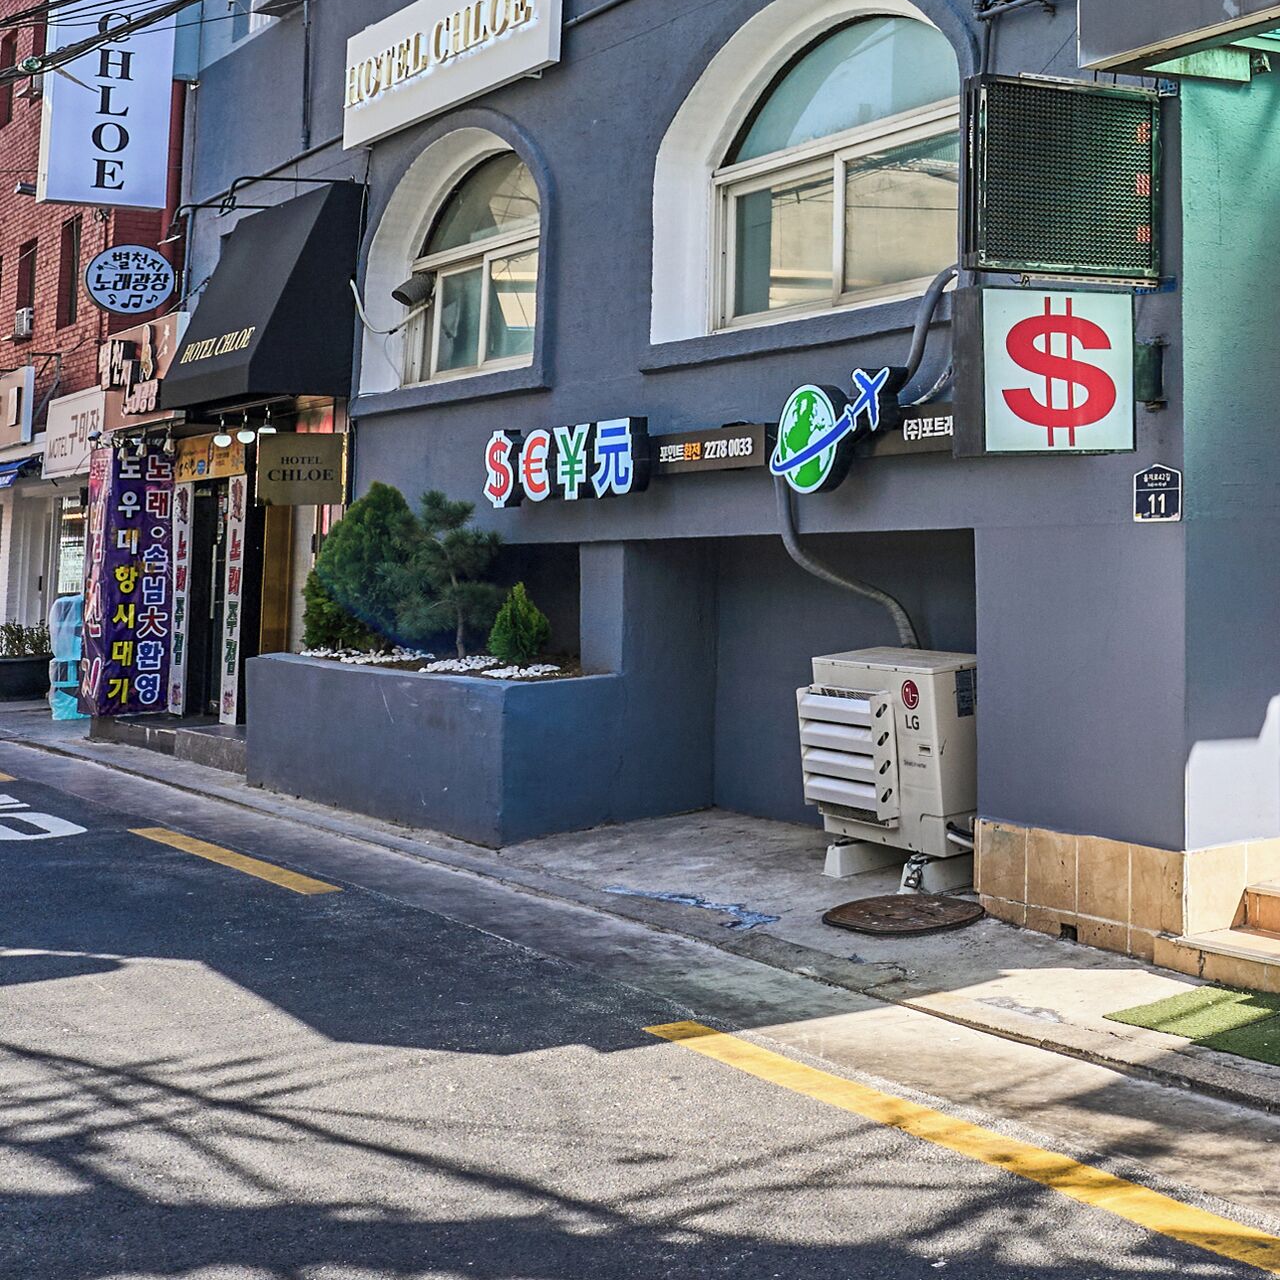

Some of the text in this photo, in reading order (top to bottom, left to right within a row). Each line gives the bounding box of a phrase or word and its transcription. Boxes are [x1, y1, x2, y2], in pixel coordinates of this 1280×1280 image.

[343, 39, 429, 109] HOTEL
[90, 12, 135, 192] CHLOE
[111, 251, 165, 273] 별천지
[93, 272, 171, 291] 노래광장
[180, 326, 256, 365] HOTEL CHLOE
[281, 455, 323, 465] HOTEL
[267, 468, 334, 482] CHLOE
[1147, 493, 1166, 514] 11
[905, 714, 920, 730] LG
